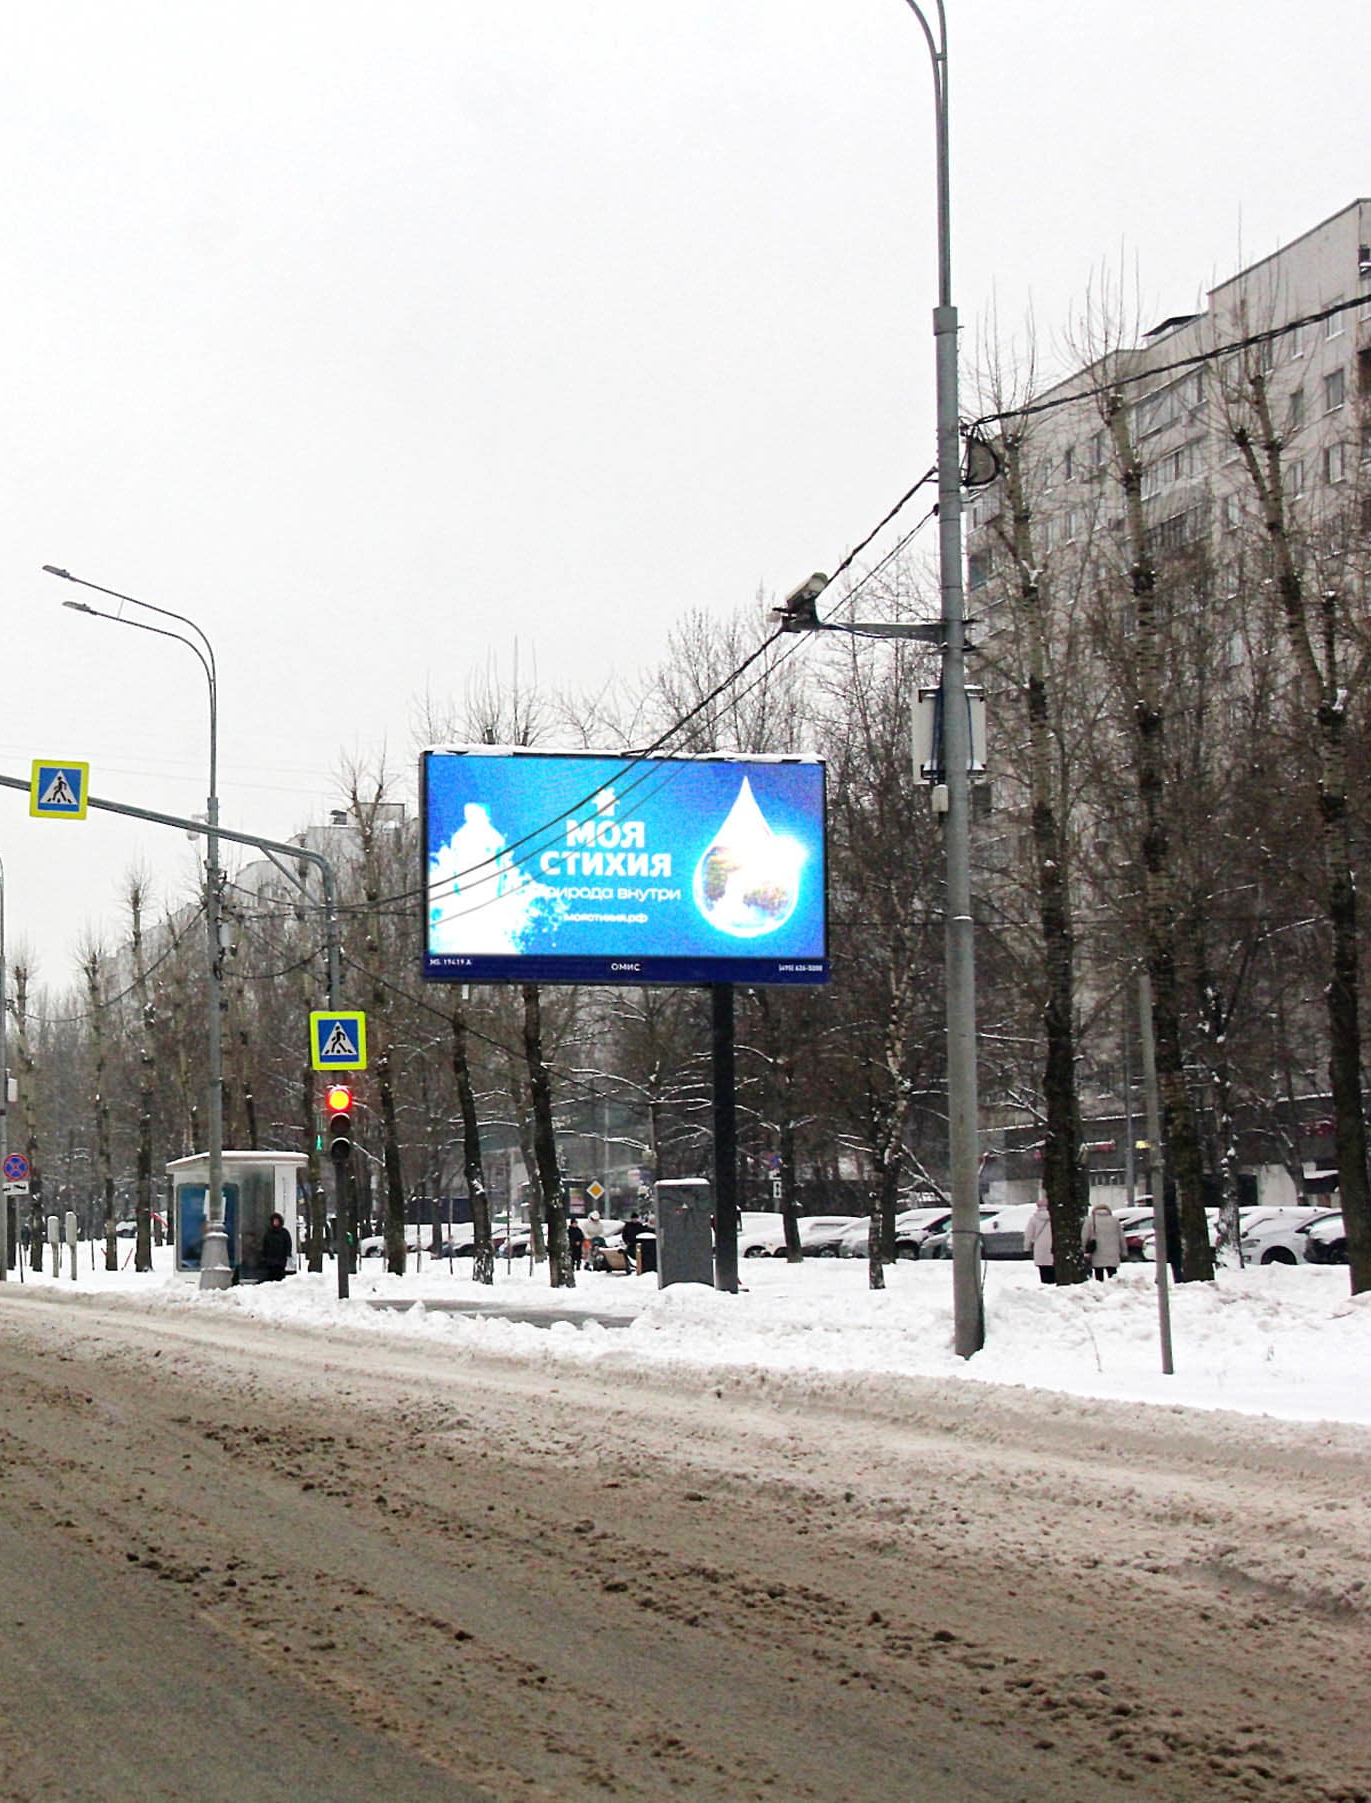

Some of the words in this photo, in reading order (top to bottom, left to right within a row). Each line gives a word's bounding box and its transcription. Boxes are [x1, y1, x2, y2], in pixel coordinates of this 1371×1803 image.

[566, 819, 645, 848] МОЯ
[539, 851, 672, 877] СТИХИЯ
[539, 886, 614, 900] рирода
[617, 888, 681, 902] внутри
